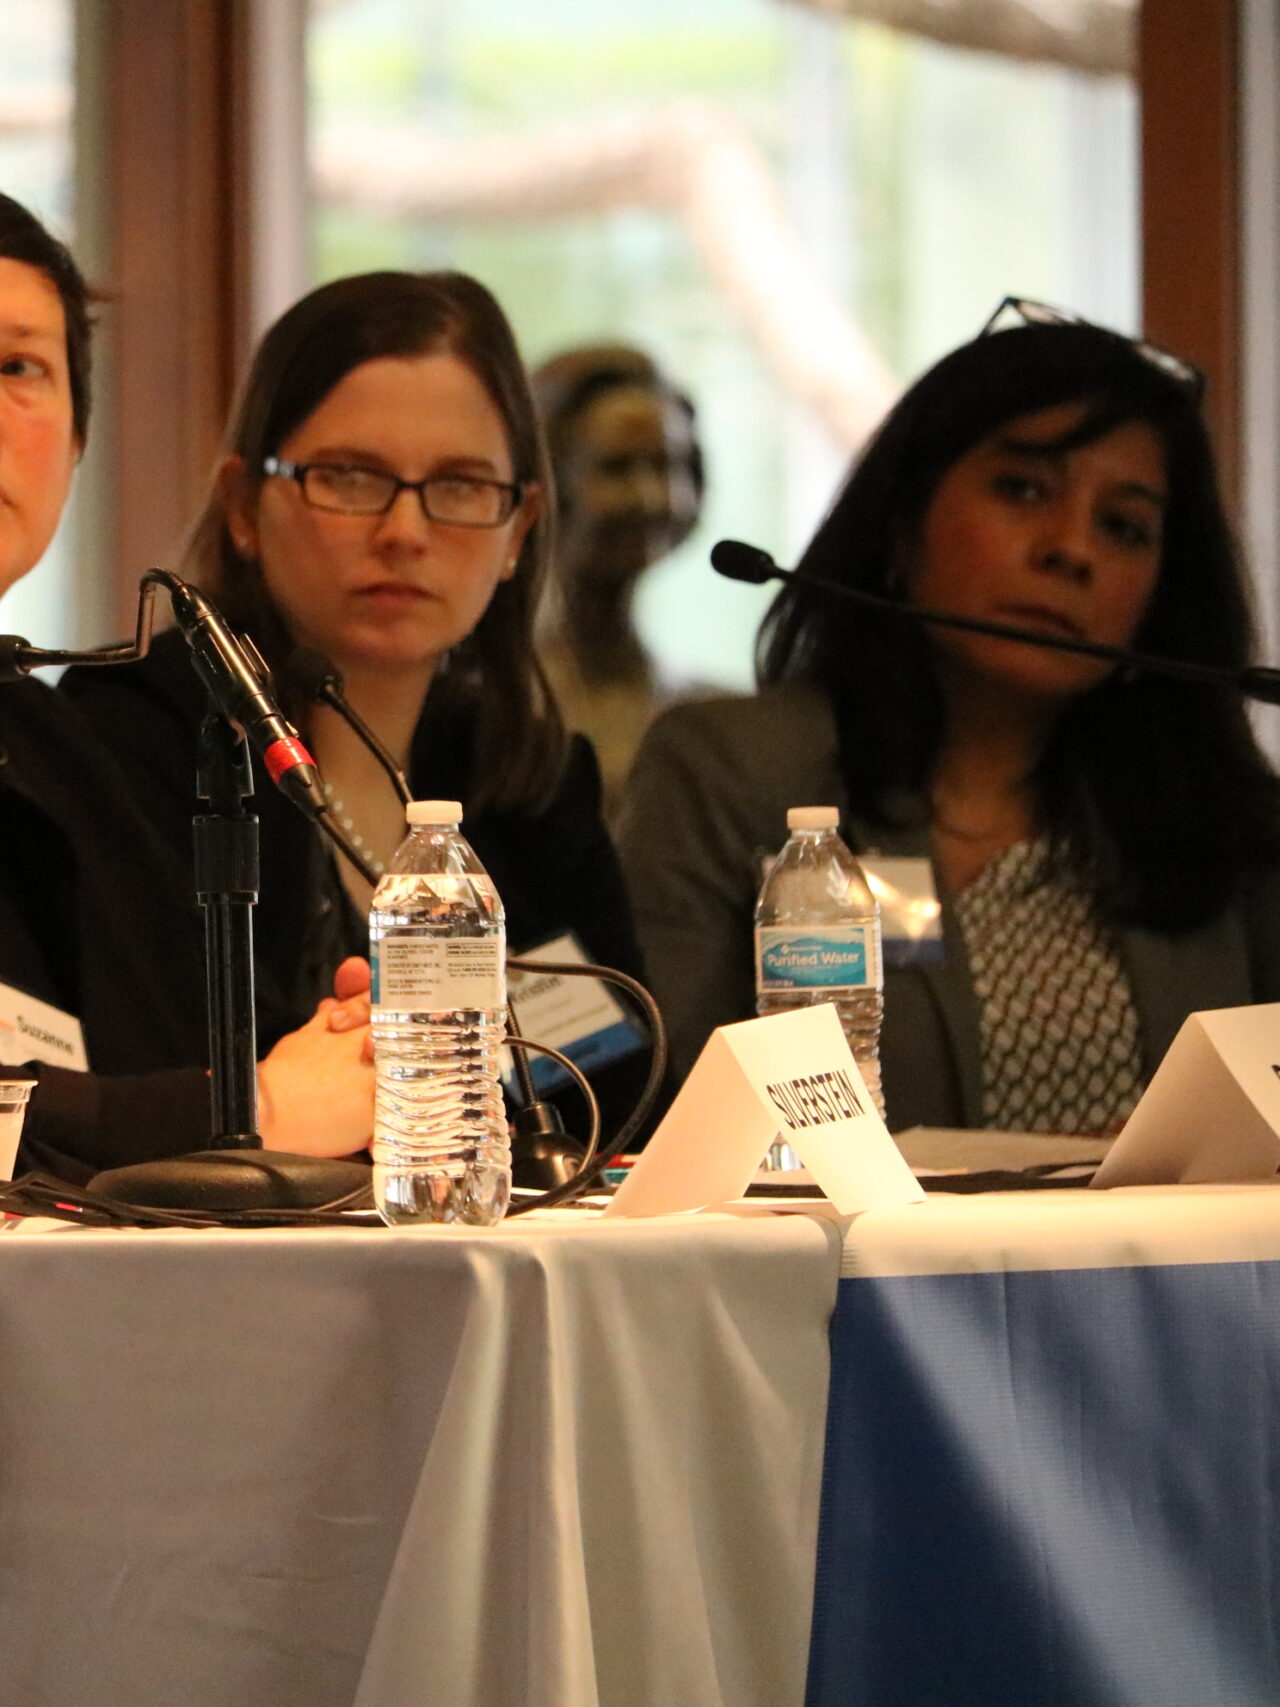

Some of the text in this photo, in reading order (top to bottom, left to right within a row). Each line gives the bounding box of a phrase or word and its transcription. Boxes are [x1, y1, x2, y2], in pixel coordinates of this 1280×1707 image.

[767, 951, 860, 967] Purified Water
[766, 1068, 865, 1130] SILVERSTEIN
